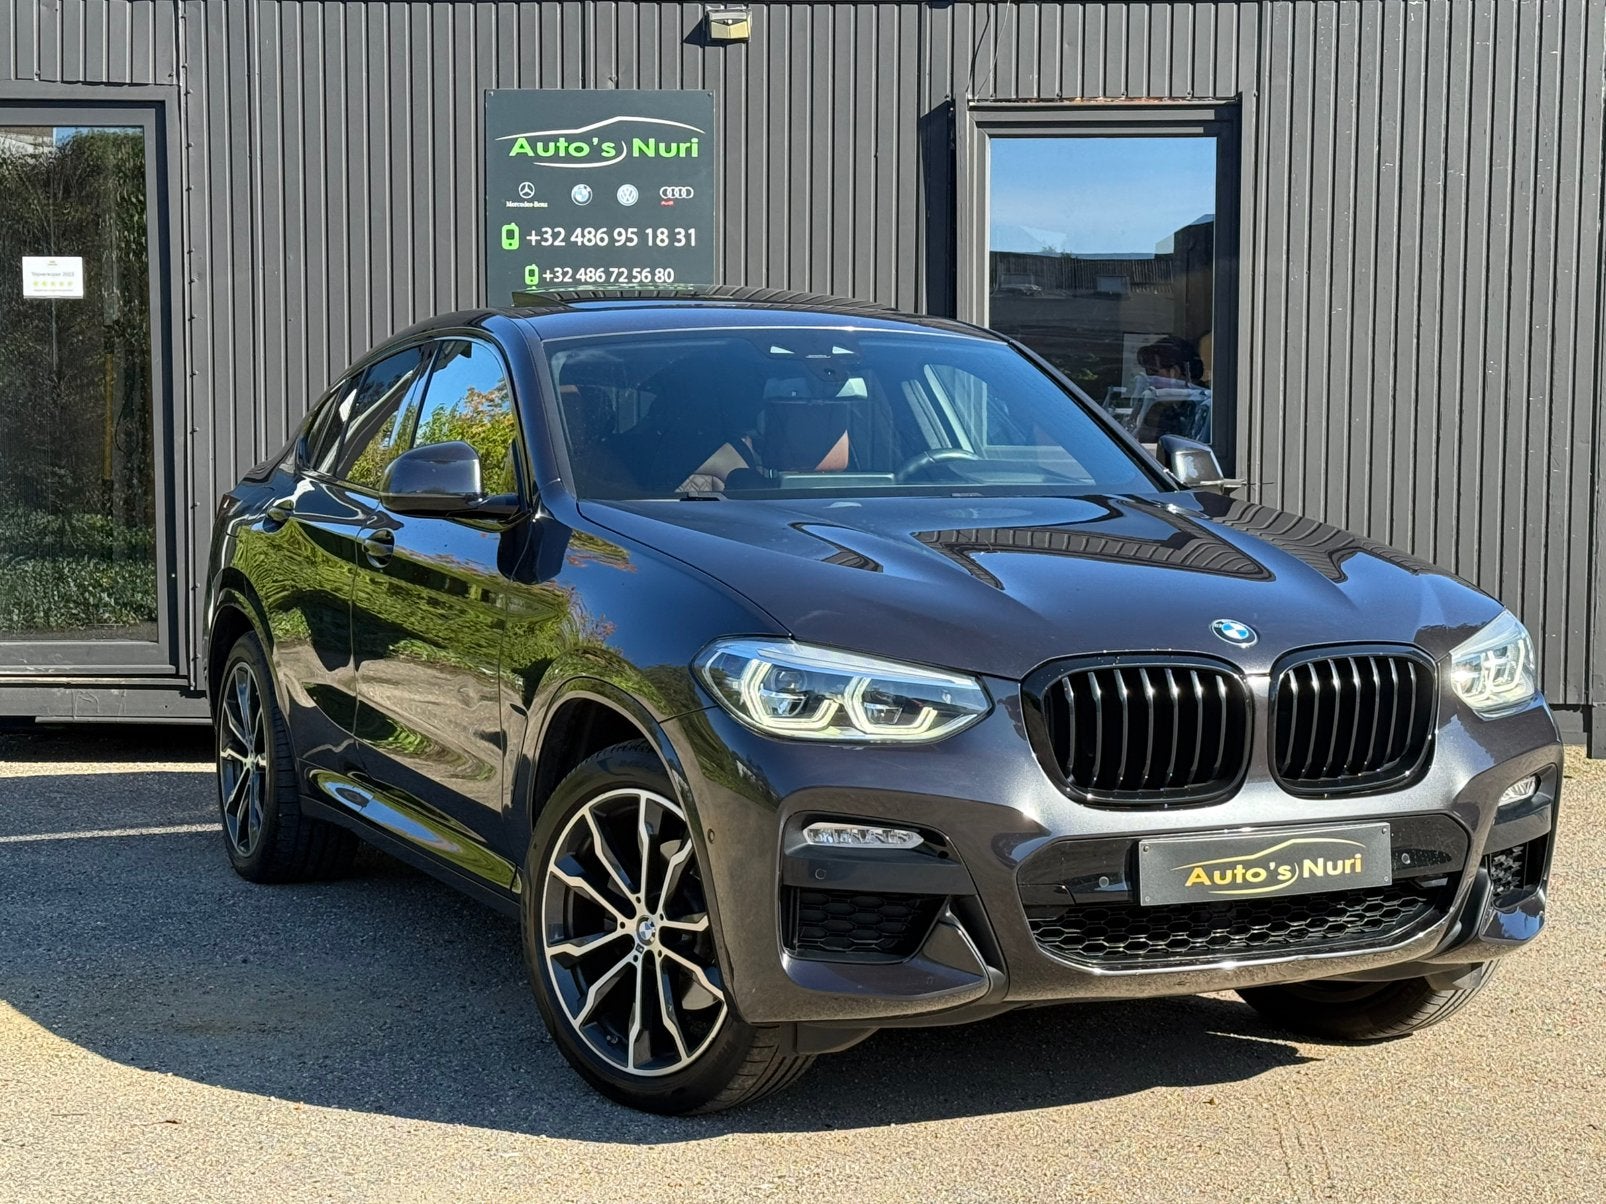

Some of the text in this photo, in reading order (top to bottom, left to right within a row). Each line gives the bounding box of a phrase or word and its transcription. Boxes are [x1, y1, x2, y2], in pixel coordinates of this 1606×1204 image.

[509, 137, 699, 158] Auto's Nuri
[526, 228, 696, 247] +32 486 95 18 31
[542, 267, 675, 283] +32 486 72 56 80
[1185, 853, 1362, 887] Auto's Nuri
